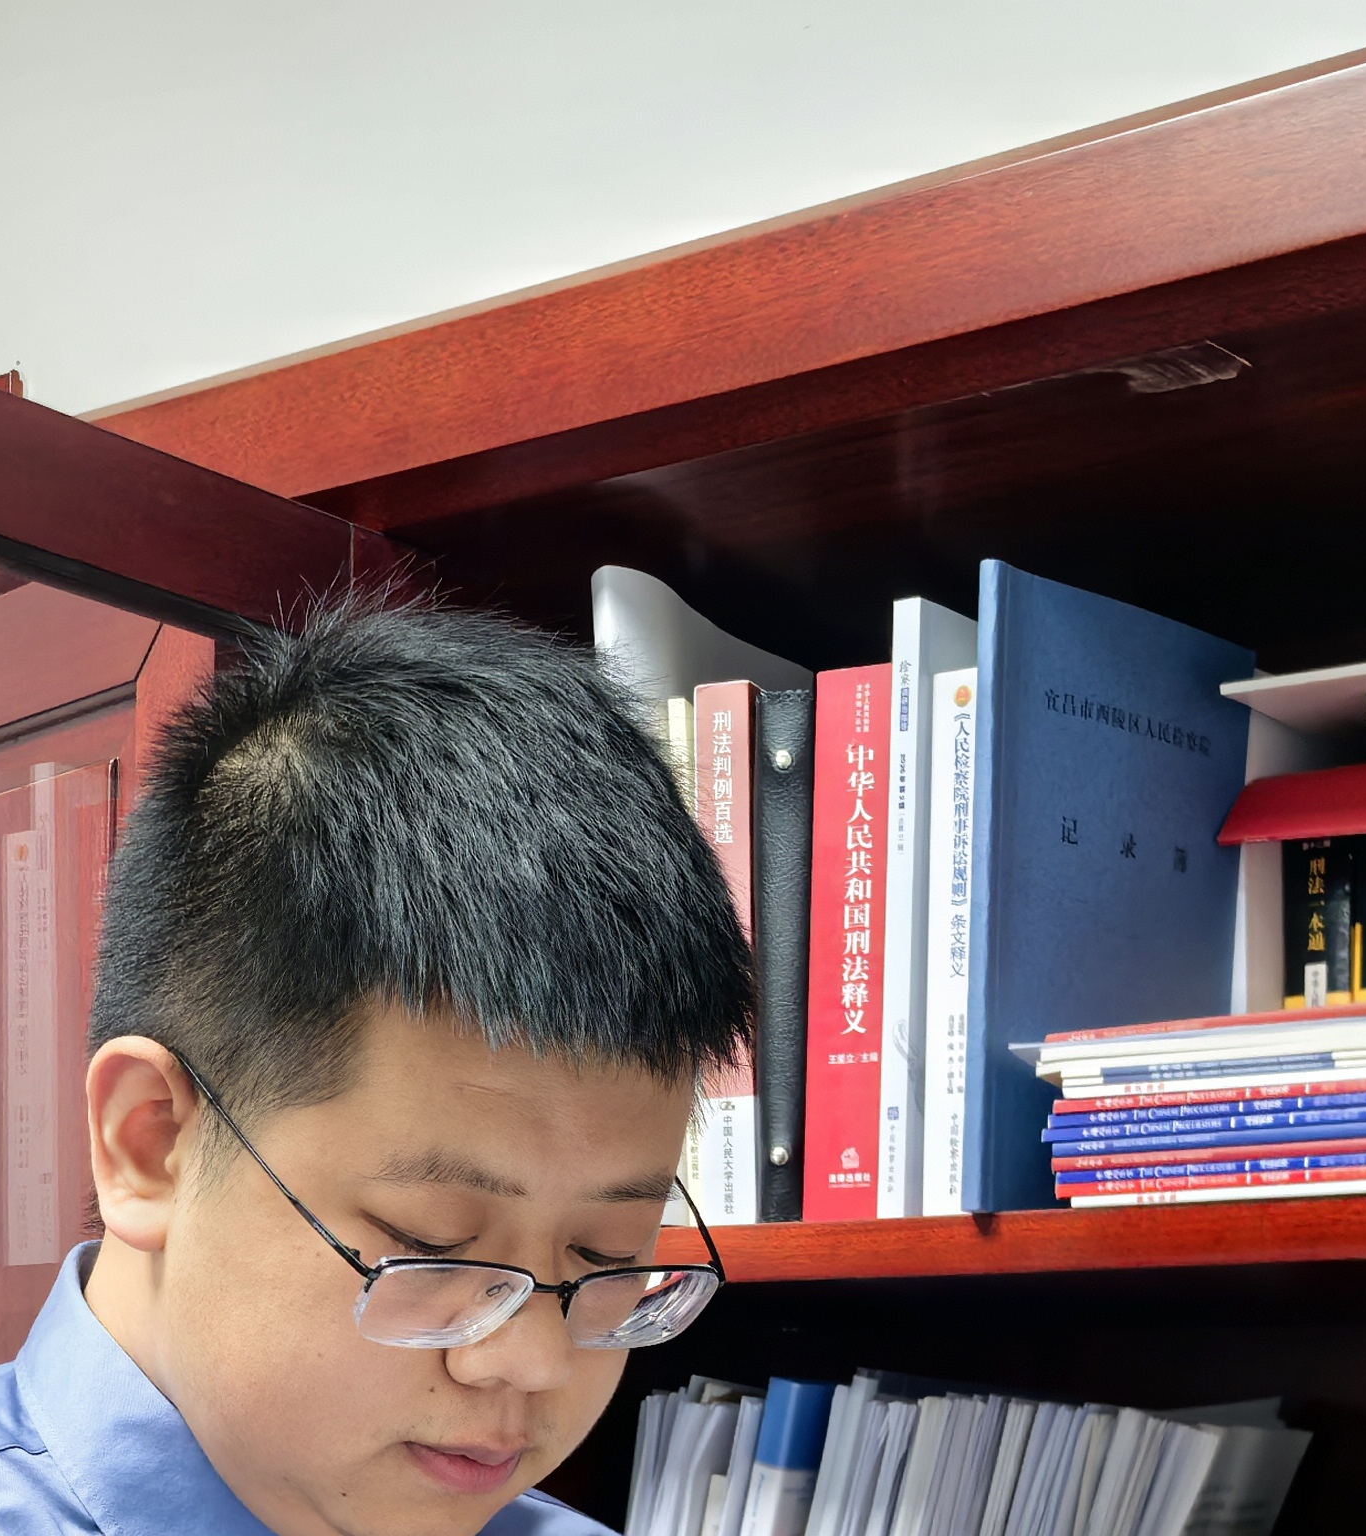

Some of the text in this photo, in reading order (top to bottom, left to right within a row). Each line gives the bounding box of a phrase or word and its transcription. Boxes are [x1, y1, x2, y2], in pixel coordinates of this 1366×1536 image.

[712, 710, 733, 844] 刑法判例百选
[841, 744, 875, 1035] 中华人民共和国刑法释义
[949, 913, 967, 978] 条文释义
[723, 1114, 734, 1215] 中国人民大学出版社
